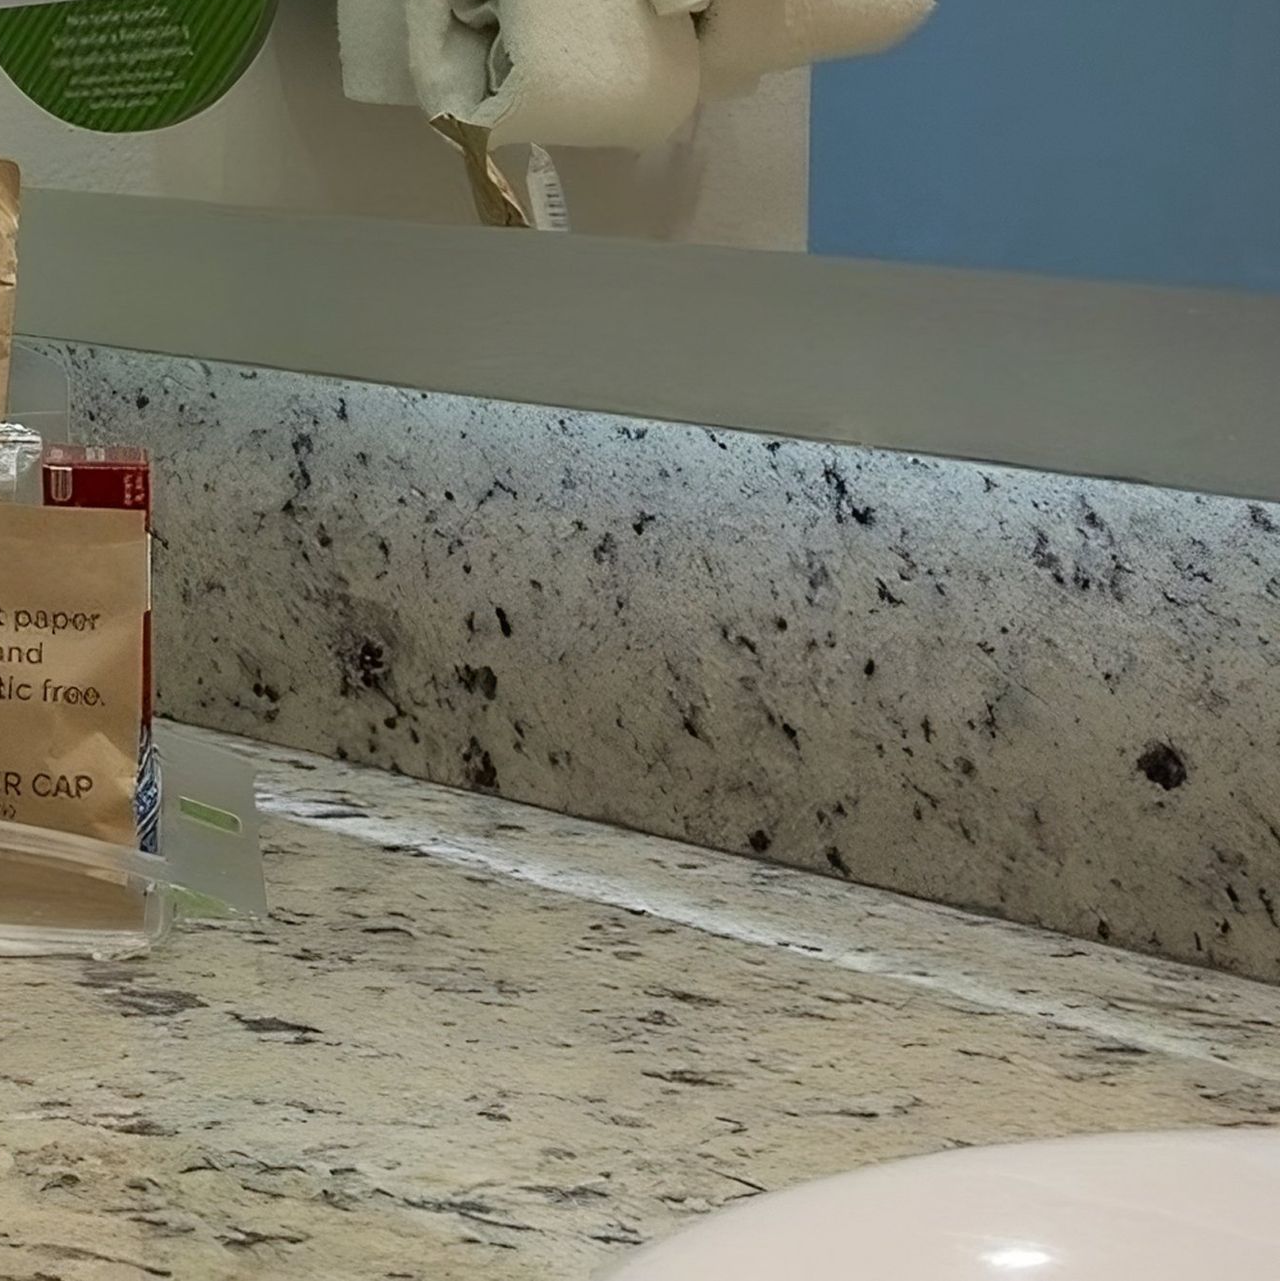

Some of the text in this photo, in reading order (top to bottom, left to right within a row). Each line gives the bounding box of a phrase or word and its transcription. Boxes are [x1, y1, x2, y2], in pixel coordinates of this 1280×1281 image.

[13, 608, 102, 636] paper
[42, 678, 106, 708] free.
[31, 772, 94, 799] CAP
